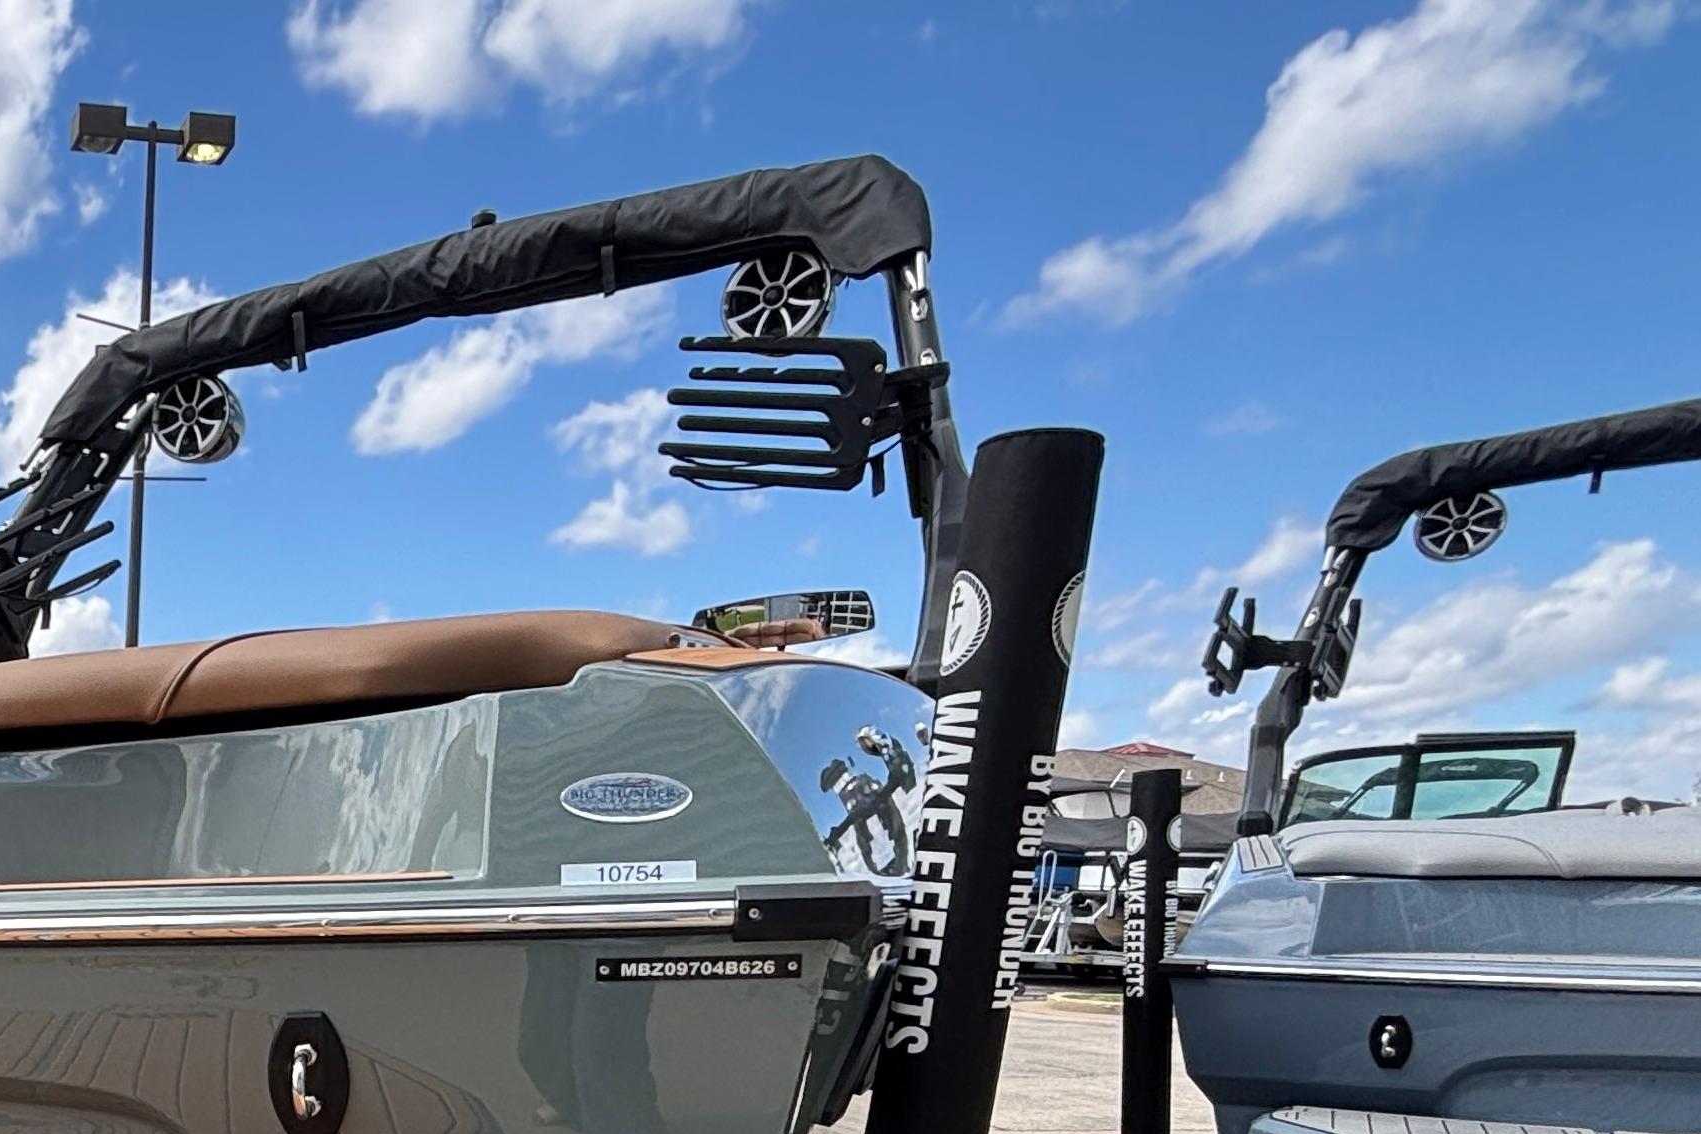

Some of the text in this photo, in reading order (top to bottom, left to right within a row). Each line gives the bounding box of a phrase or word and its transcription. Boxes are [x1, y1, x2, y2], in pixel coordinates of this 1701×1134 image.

[597, 864, 664, 882] 10754
[884, 690, 982, 1055] WAKE EFFECTS
[991, 754, 1057, 1009] BY BIG THUNDER
[1125, 859, 1147, 998] WAKE EFFECTS
[620, 960, 776, 977] MBZ09704B626
